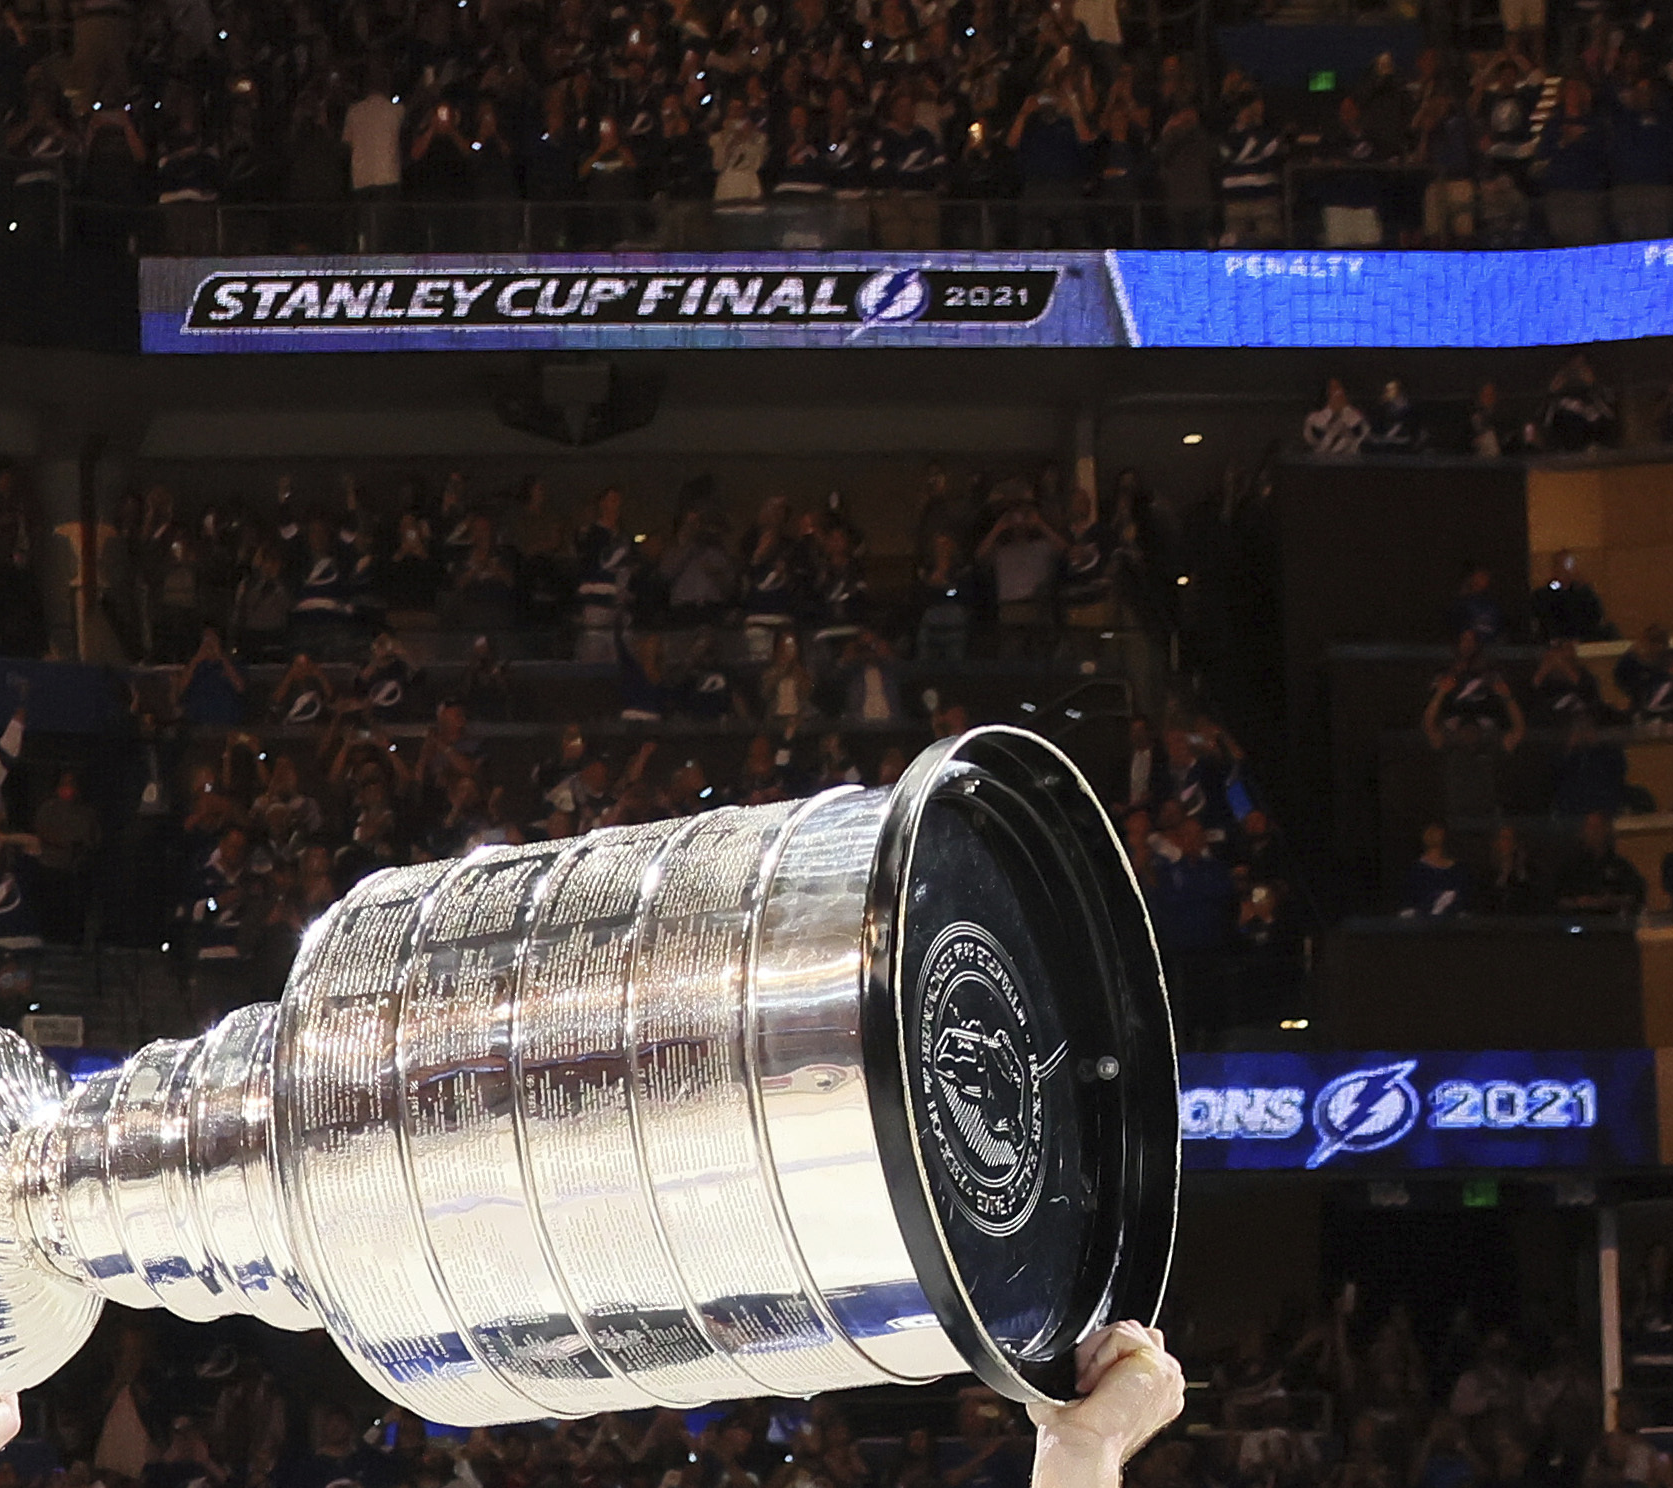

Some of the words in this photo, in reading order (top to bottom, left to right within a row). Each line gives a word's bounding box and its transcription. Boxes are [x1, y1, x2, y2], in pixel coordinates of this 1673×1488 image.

[1224, 255, 1365, 279] PENALTY
[209, 279, 494, 321] STANLEY
[495, 277, 628, 319] CUP
[632, 276, 849, 318] FINAL
[941, 286, 1029, 310] 2021
[1430, 1078, 1599, 1130] 2021
